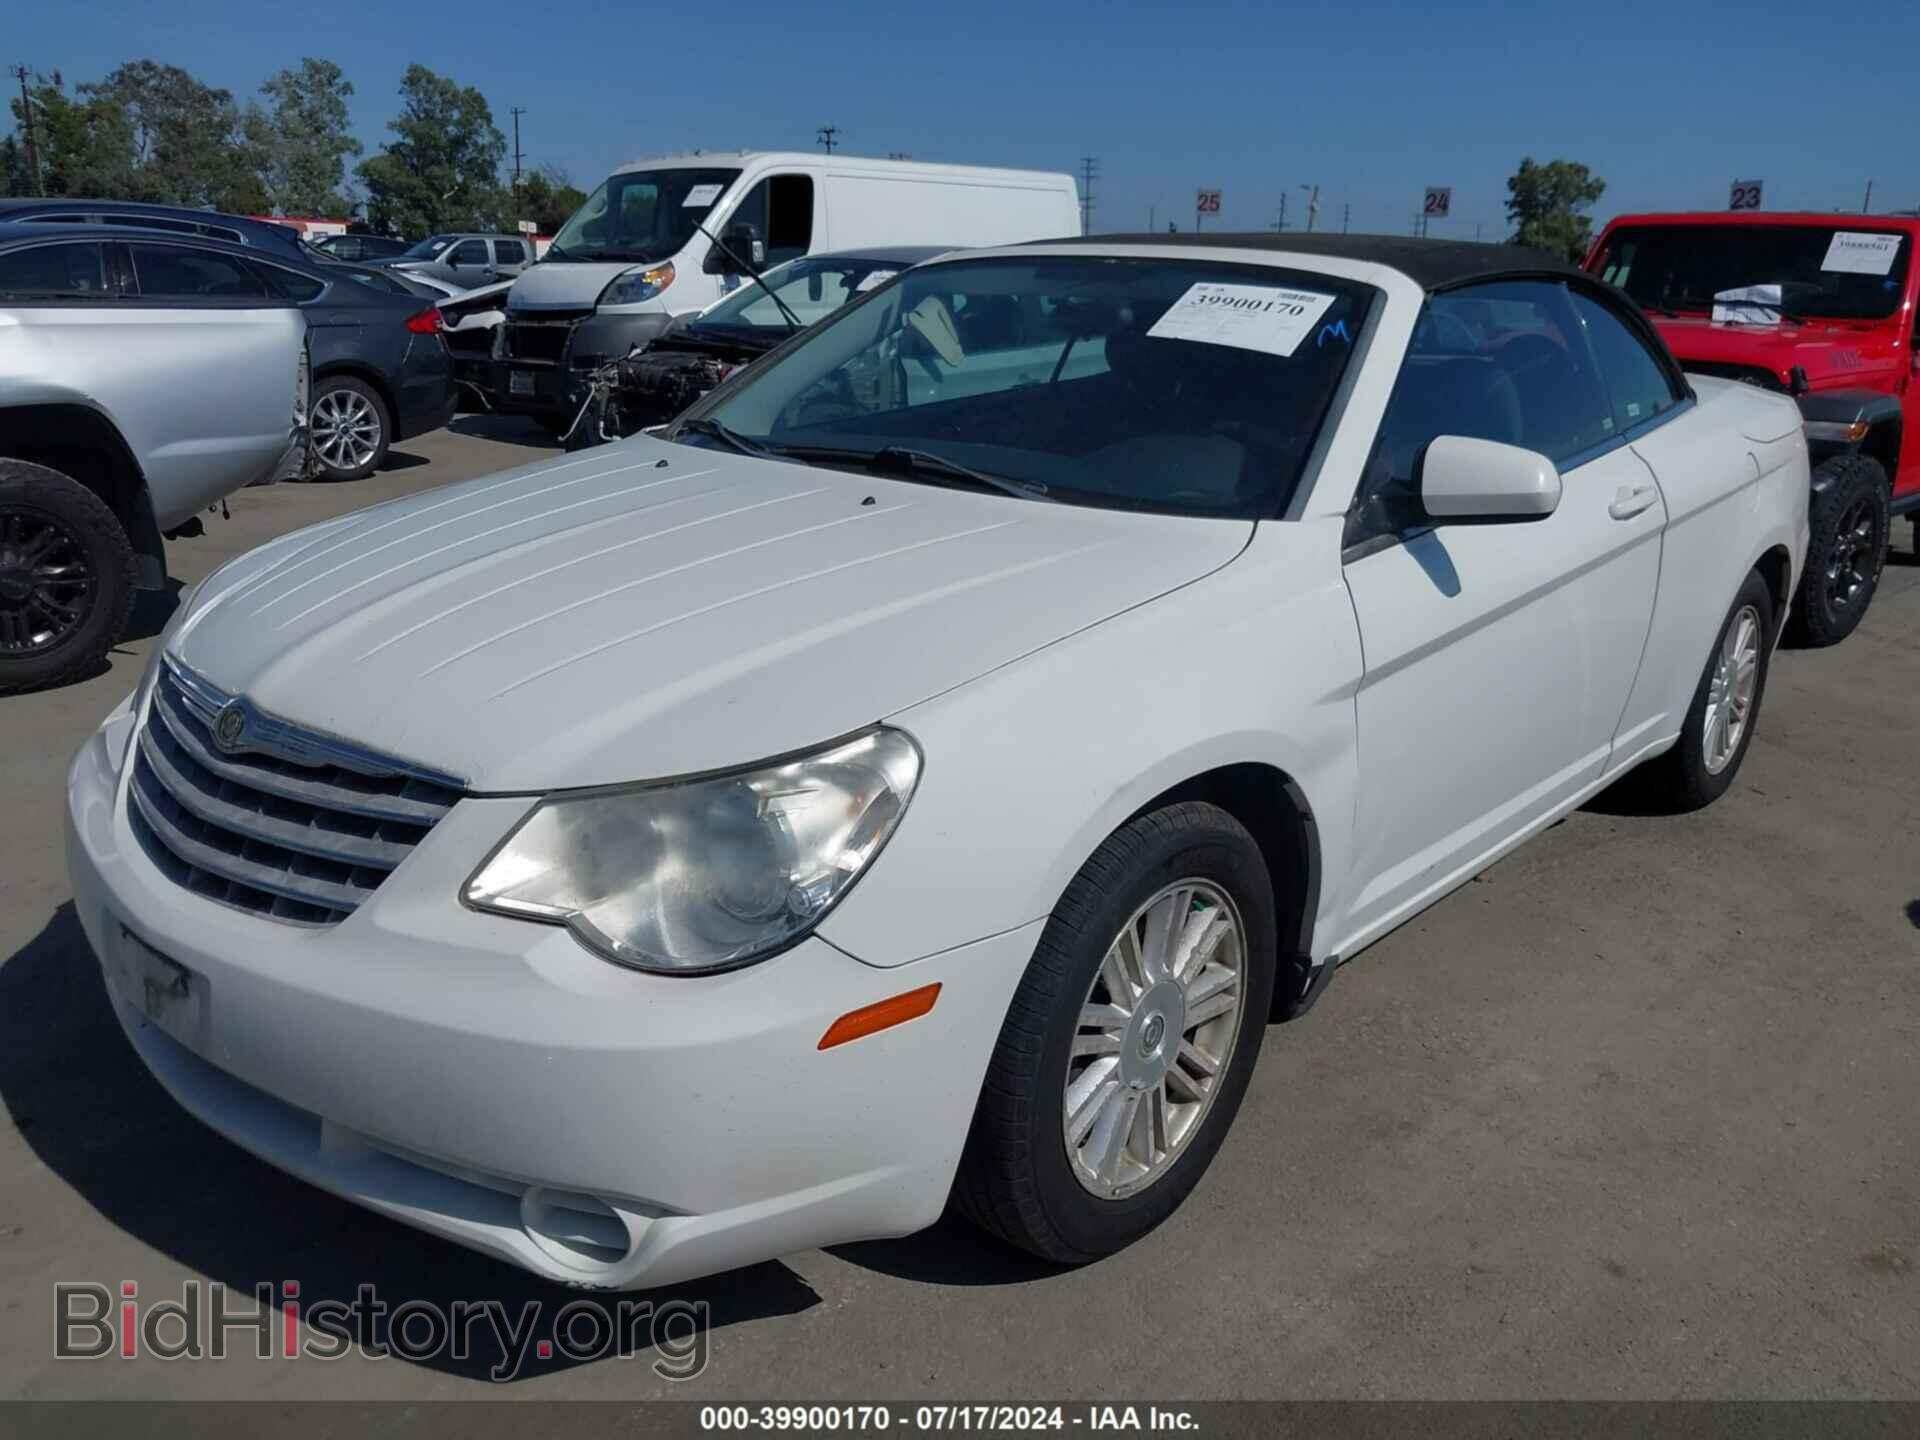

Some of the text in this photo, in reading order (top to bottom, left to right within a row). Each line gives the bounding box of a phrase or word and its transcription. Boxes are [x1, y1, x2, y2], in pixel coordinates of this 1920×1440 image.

[1198, 193, 1220, 212] 25
[1425, 192, 1450, 212] 24
[1731, 186, 1761, 209] 23
[1190, 294, 1305, 317] 39900170
